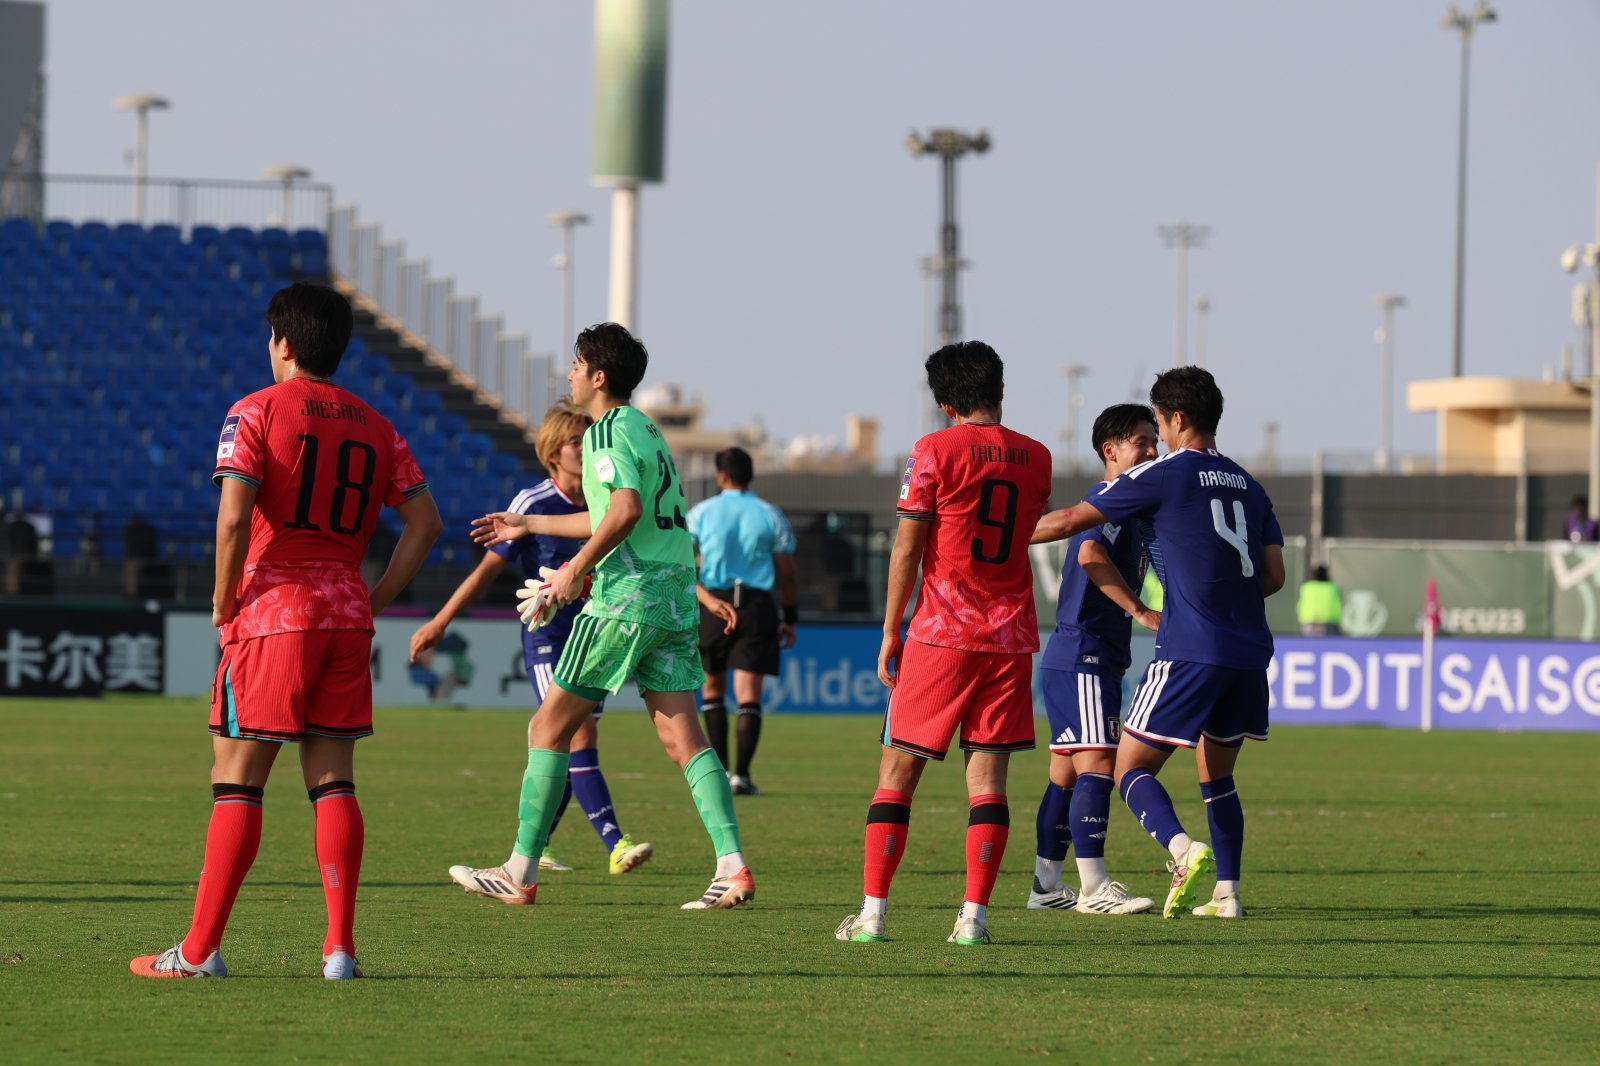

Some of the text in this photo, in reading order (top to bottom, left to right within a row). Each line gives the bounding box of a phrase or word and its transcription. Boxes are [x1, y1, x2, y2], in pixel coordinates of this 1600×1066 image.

[300, 399, 367, 425] JAESANG
[968, 444, 1029, 466] TAEWON
[1198, 470, 1248, 490] NAGANO
[283, 433, 377, 536] 18
[971, 478, 1019, 564] 9
[1210, 498, 1254, 578] 4
[0, 629, 161, 690] 卡尔美
[763, 655, 887, 707] Mide
